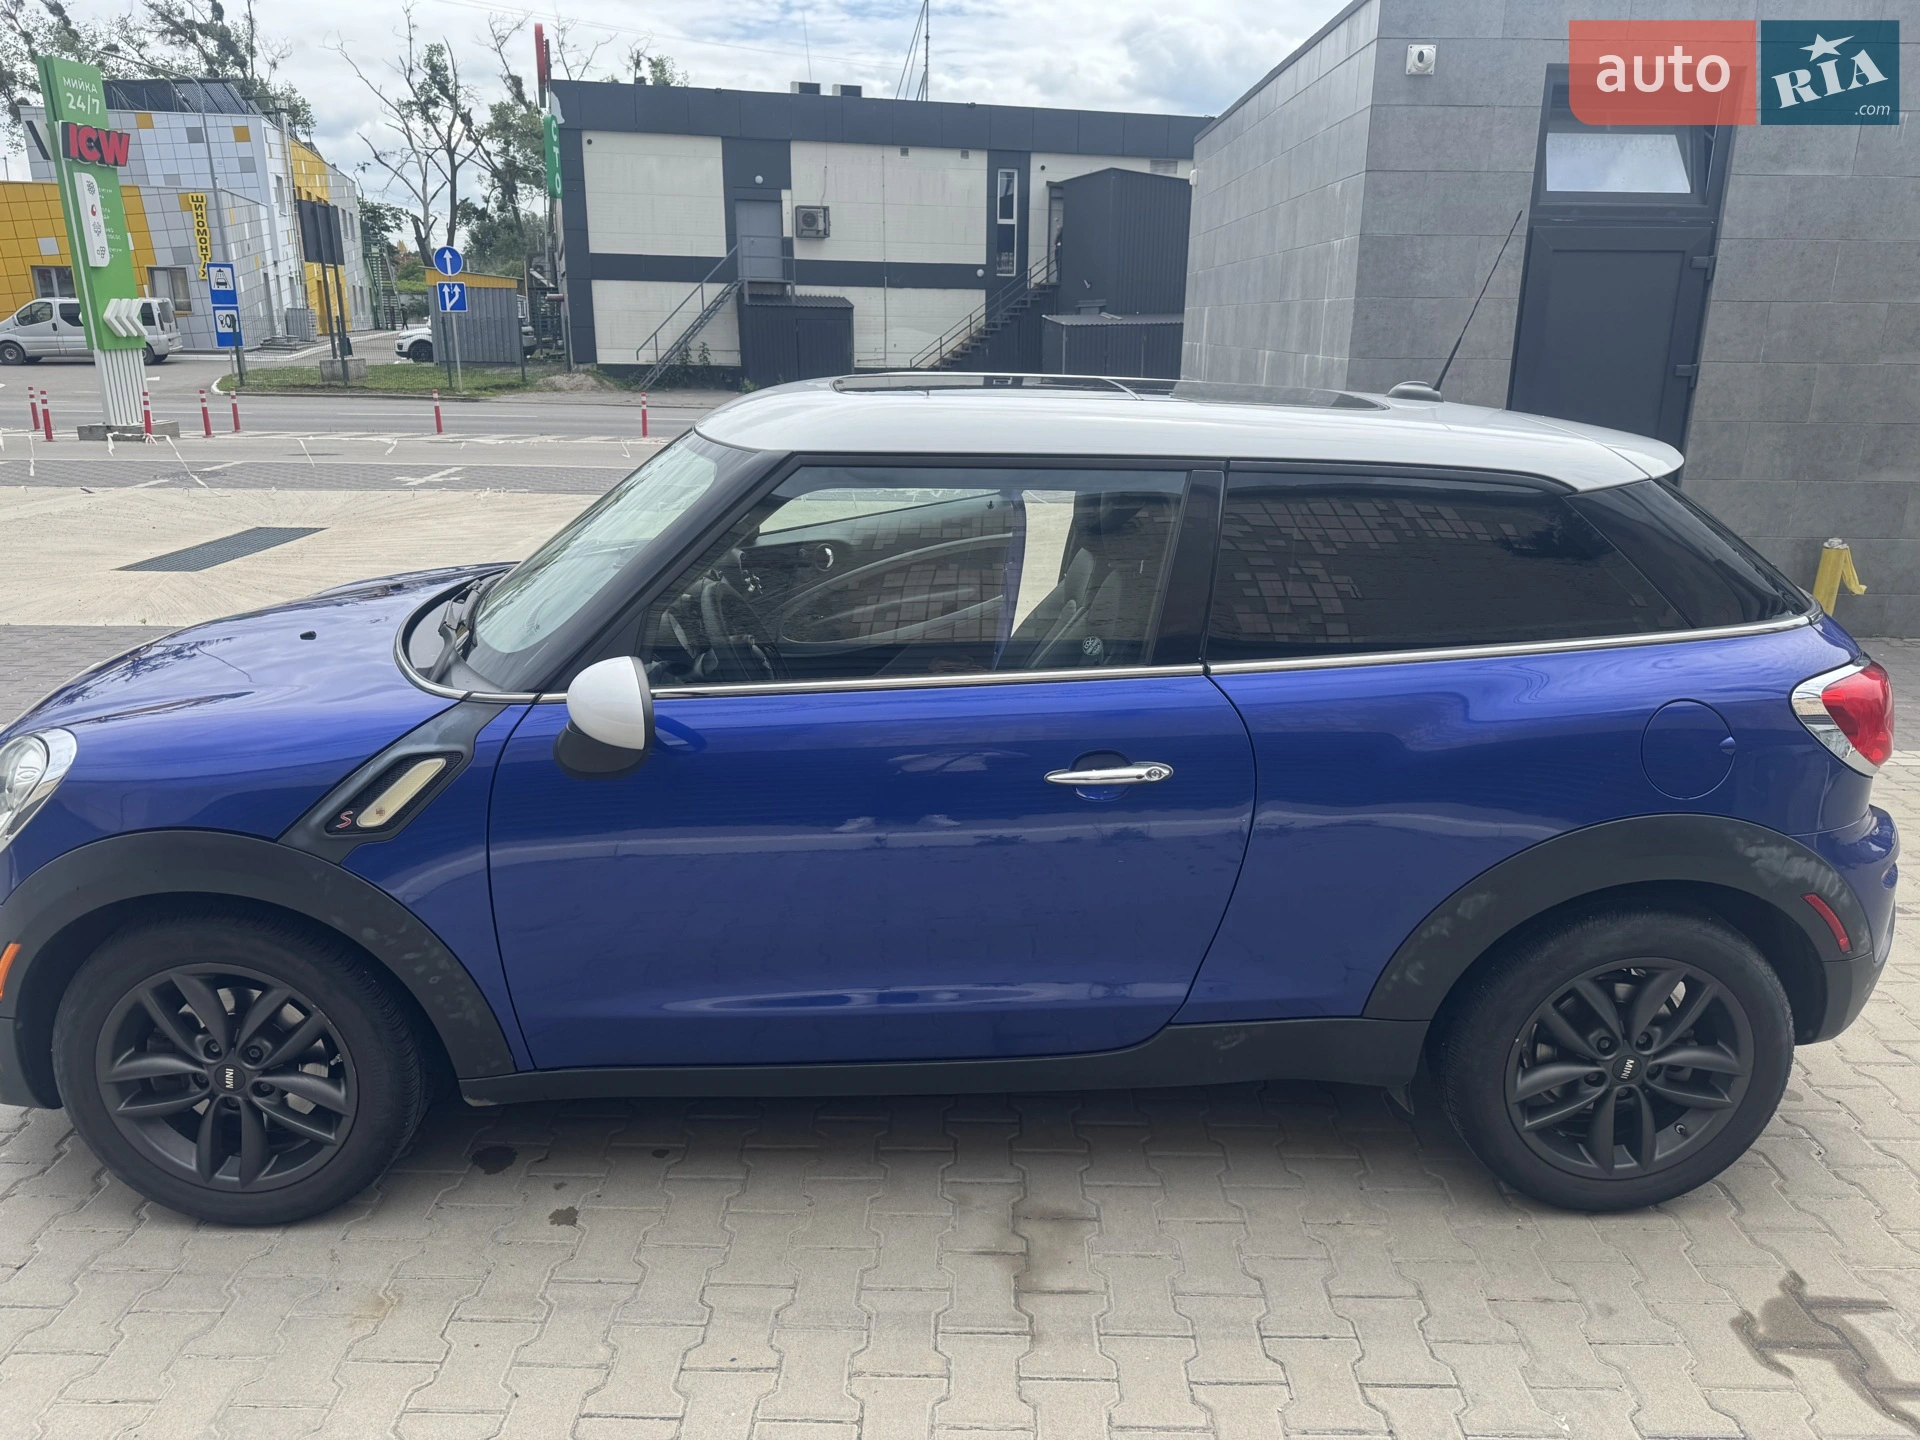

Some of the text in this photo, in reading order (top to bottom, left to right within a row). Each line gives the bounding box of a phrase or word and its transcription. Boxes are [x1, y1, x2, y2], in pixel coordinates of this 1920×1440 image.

[62, 76, 98, 94] МИЙКА
[65, 92, 100, 115] 24/7
[68, 122, 131, 168] ICW
[335, 810, 354, 829] S
[225, 1068, 234, 1089] MINI
[1620, 1059, 1635, 1079] MINI
